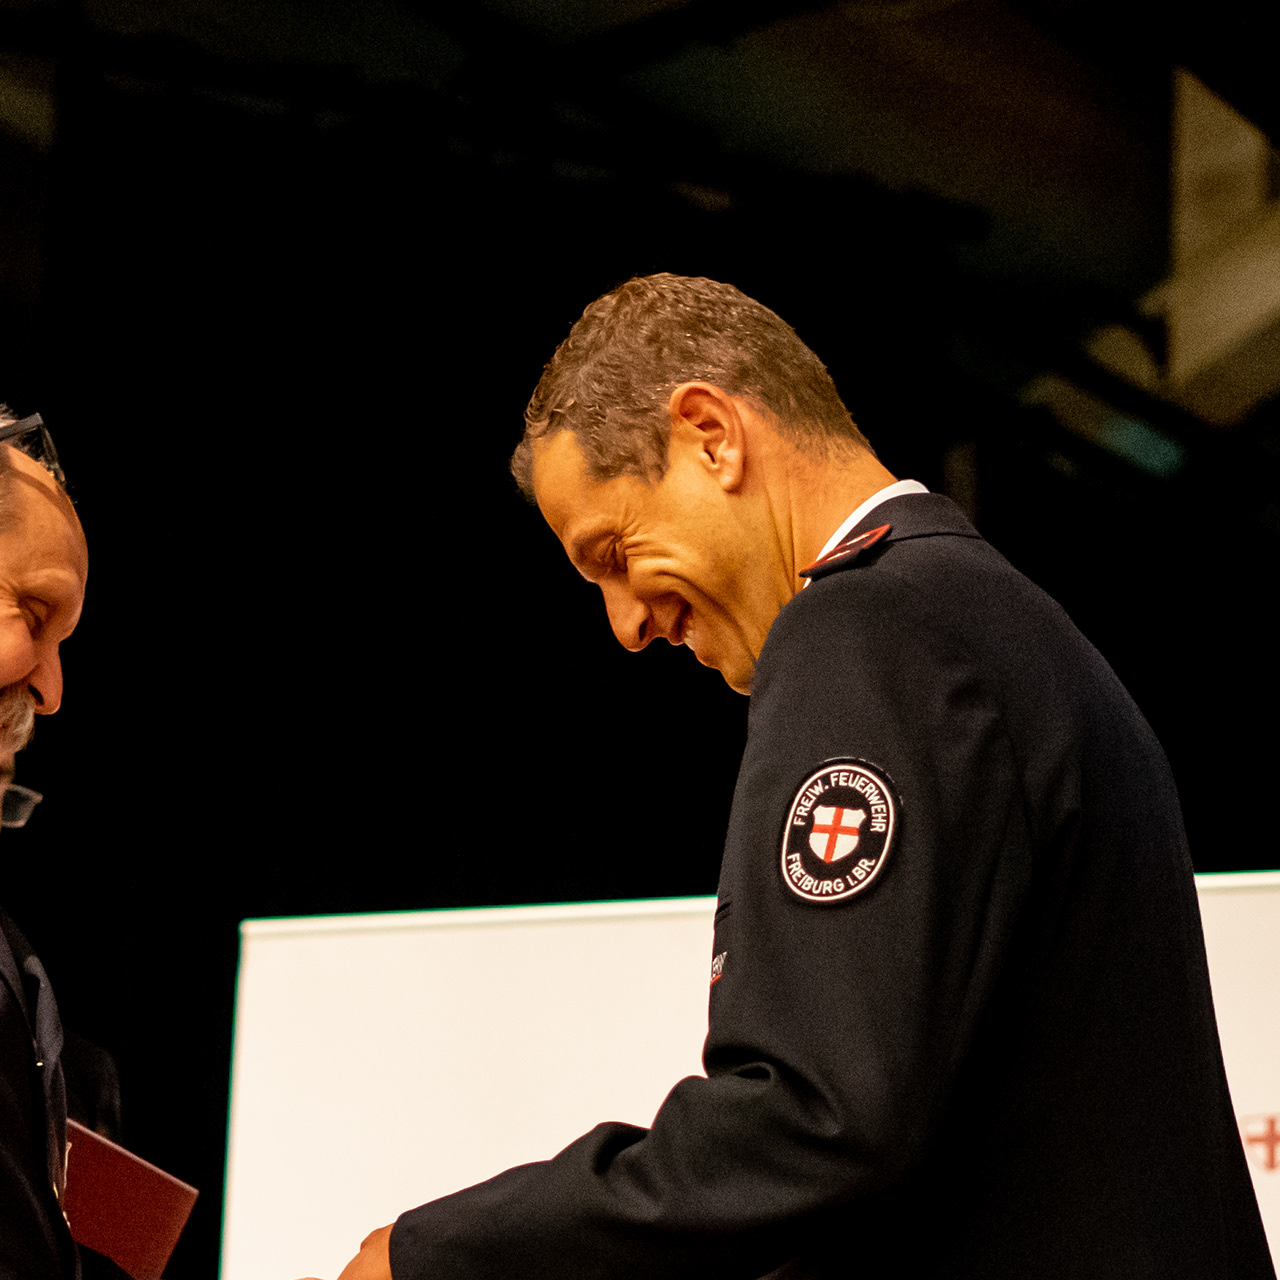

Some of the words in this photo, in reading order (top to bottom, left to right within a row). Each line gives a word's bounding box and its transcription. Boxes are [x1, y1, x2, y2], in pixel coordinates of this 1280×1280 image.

[793, 779, 829, 826] FREIW.
[830, 772, 887, 833] FEUERWEHR
[787, 852, 844, 895] FREIBURG
